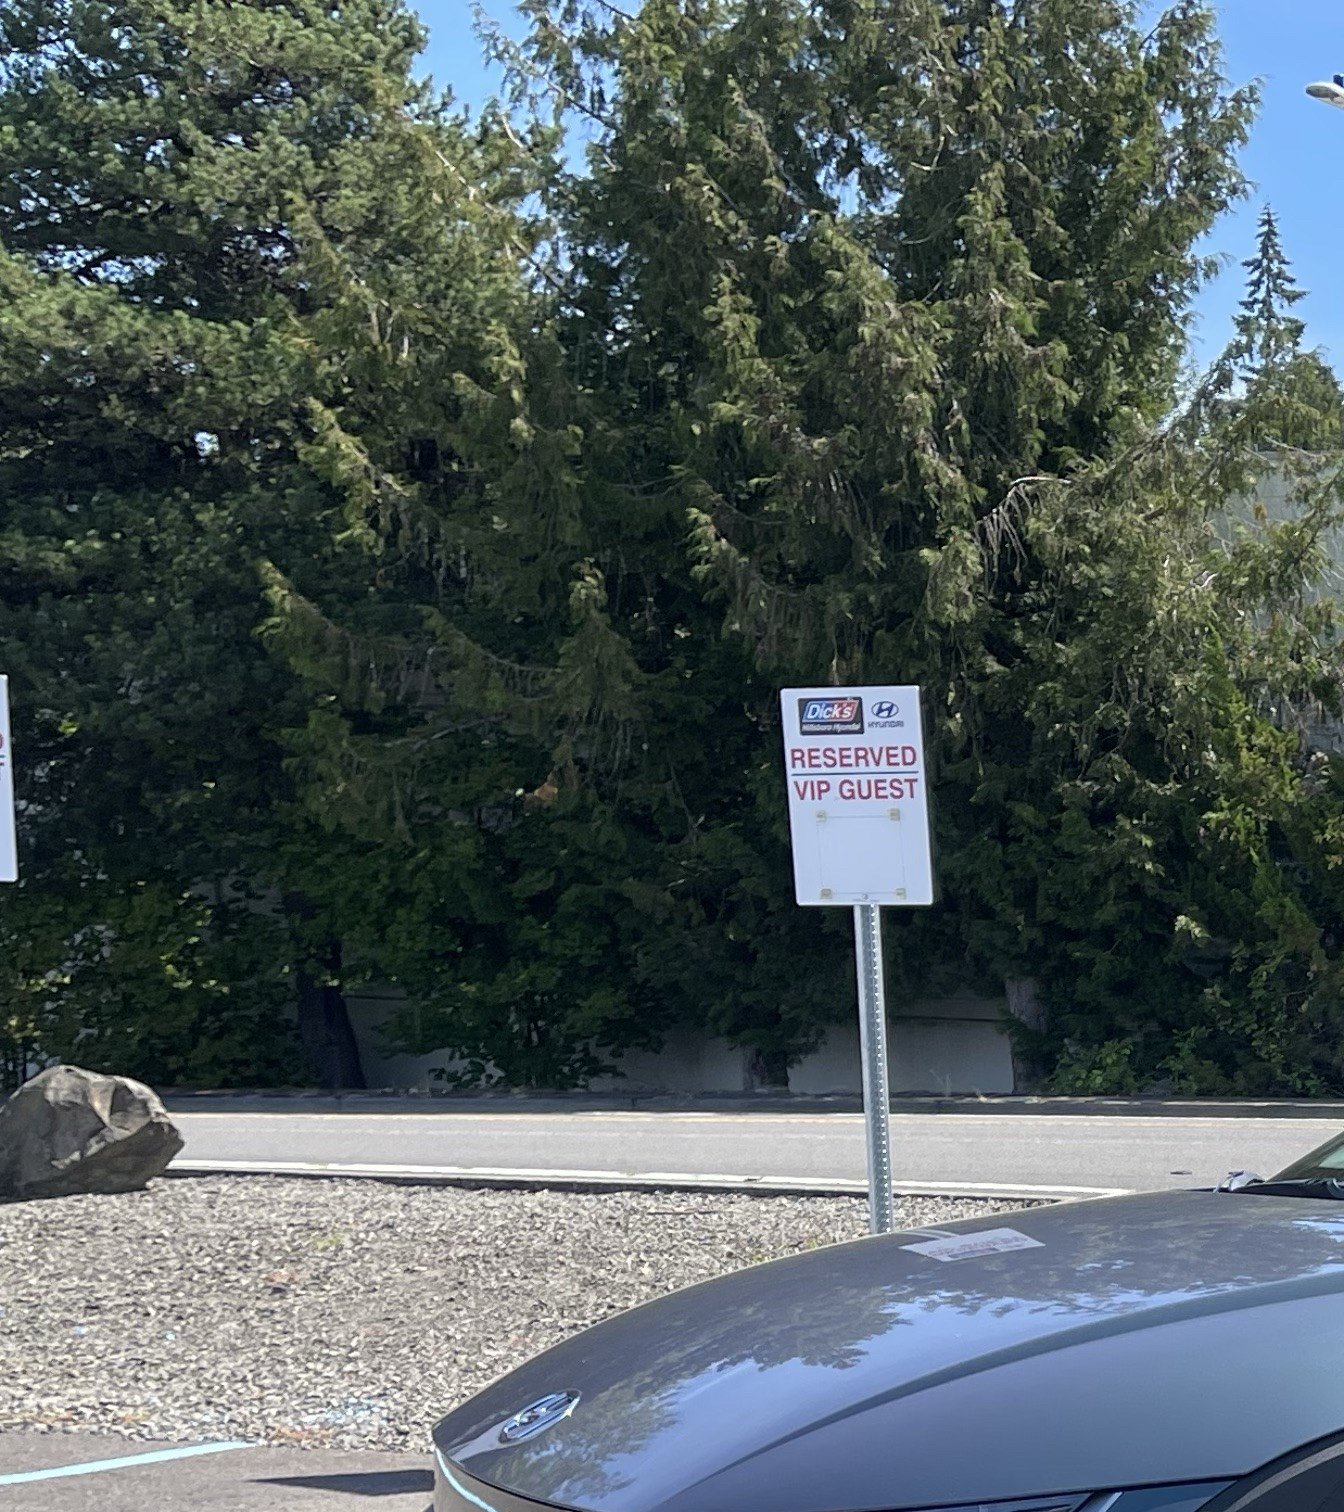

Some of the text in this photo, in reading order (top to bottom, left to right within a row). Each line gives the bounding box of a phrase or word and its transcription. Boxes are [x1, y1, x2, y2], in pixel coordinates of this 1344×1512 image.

[790, 745, 918, 769] RESERVED
[793, 778, 919, 801] VIP GUEST
